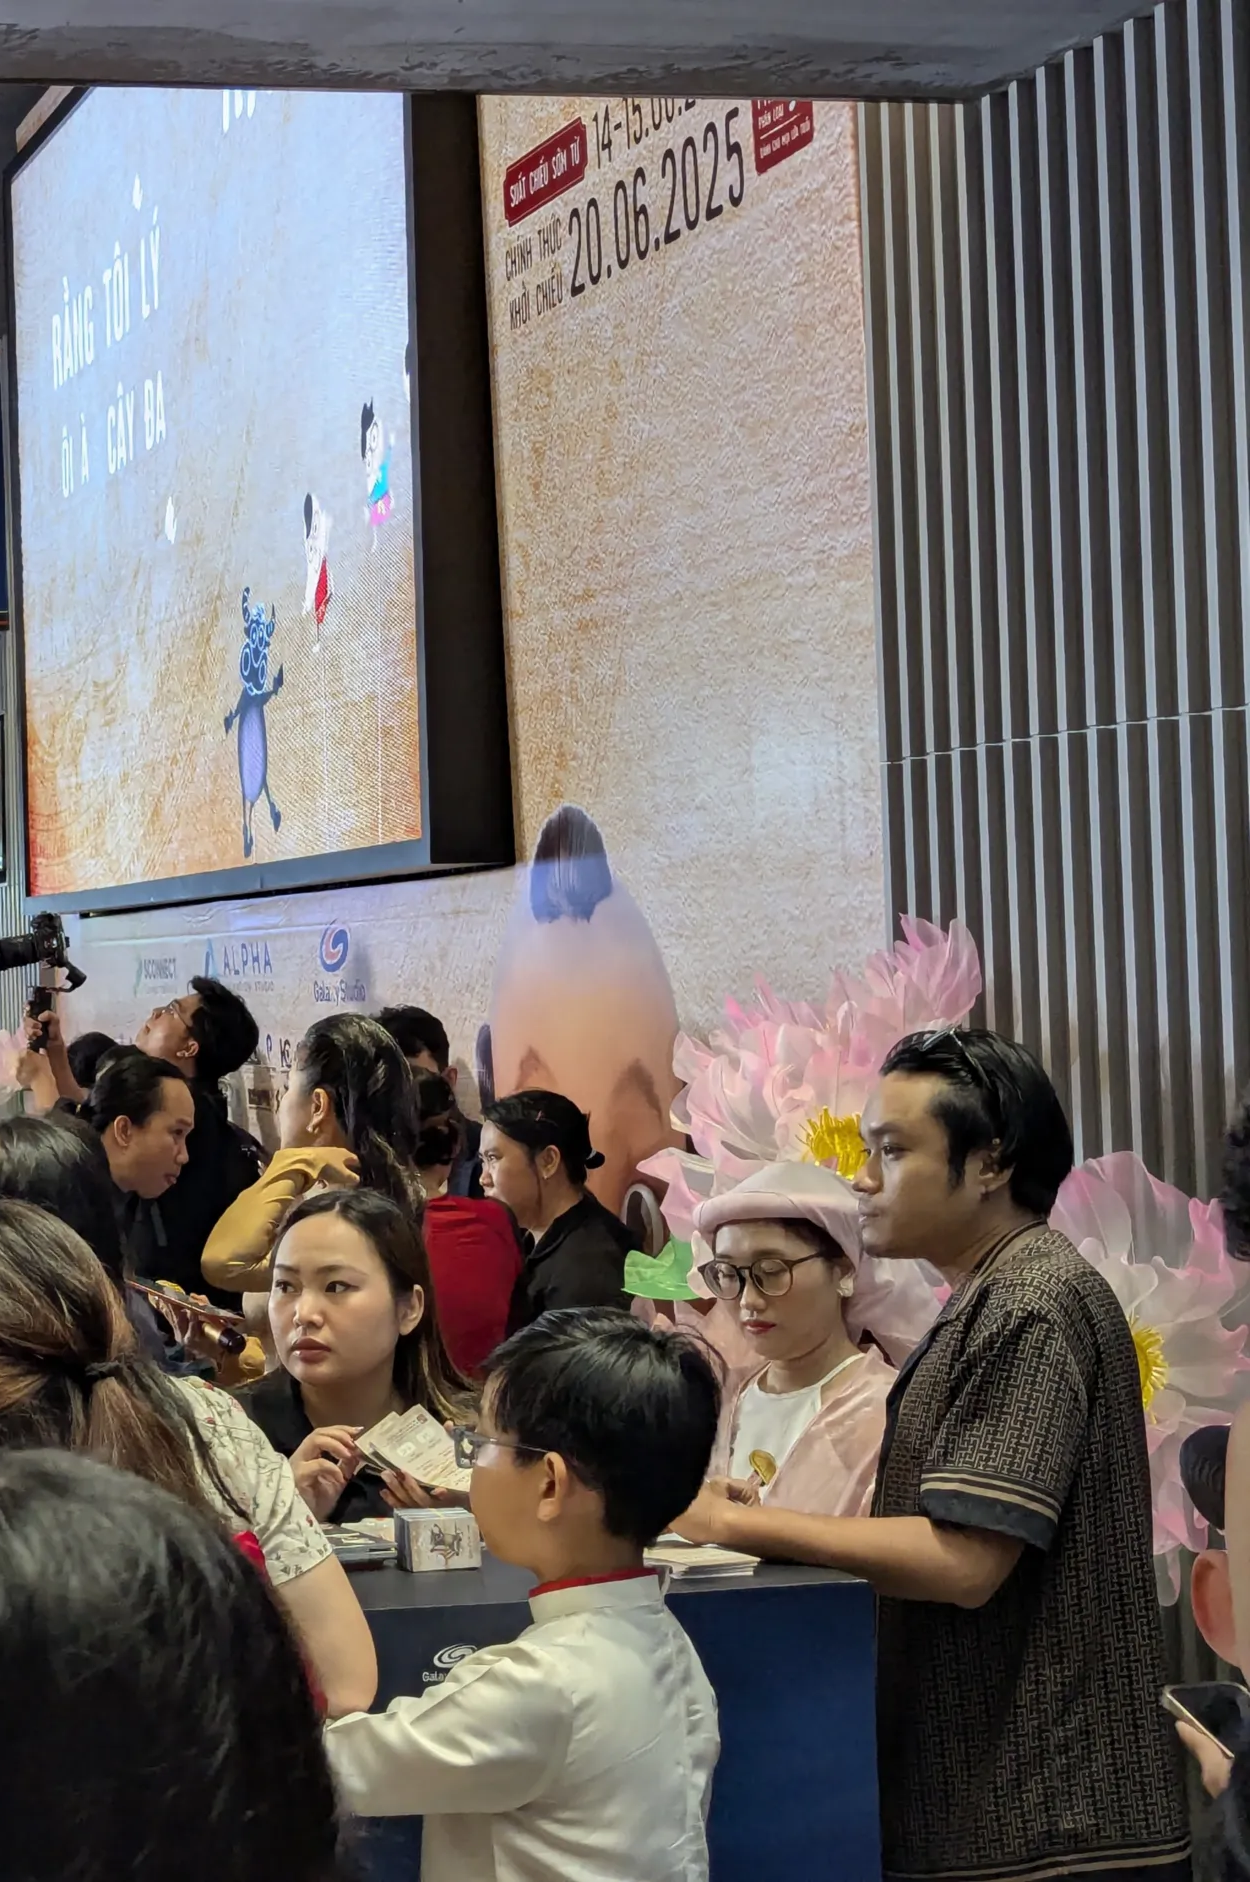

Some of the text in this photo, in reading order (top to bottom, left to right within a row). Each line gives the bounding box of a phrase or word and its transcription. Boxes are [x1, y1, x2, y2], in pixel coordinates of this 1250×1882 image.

[592, 97, 696, 169] 14-15.0.
[568, 106, 745, 298] 20.06.2025
[103, 240, 130, 348] TÔI
[140, 205, 160, 320] LÝ
[505, 213, 562, 281] CHÍNH THỨC
[536, 261, 563, 316] CHIẾU
[107, 381, 134, 474] CÂY
[223, 942, 272, 975] ALPHA
[422, 1671, 446, 1682] Gala
